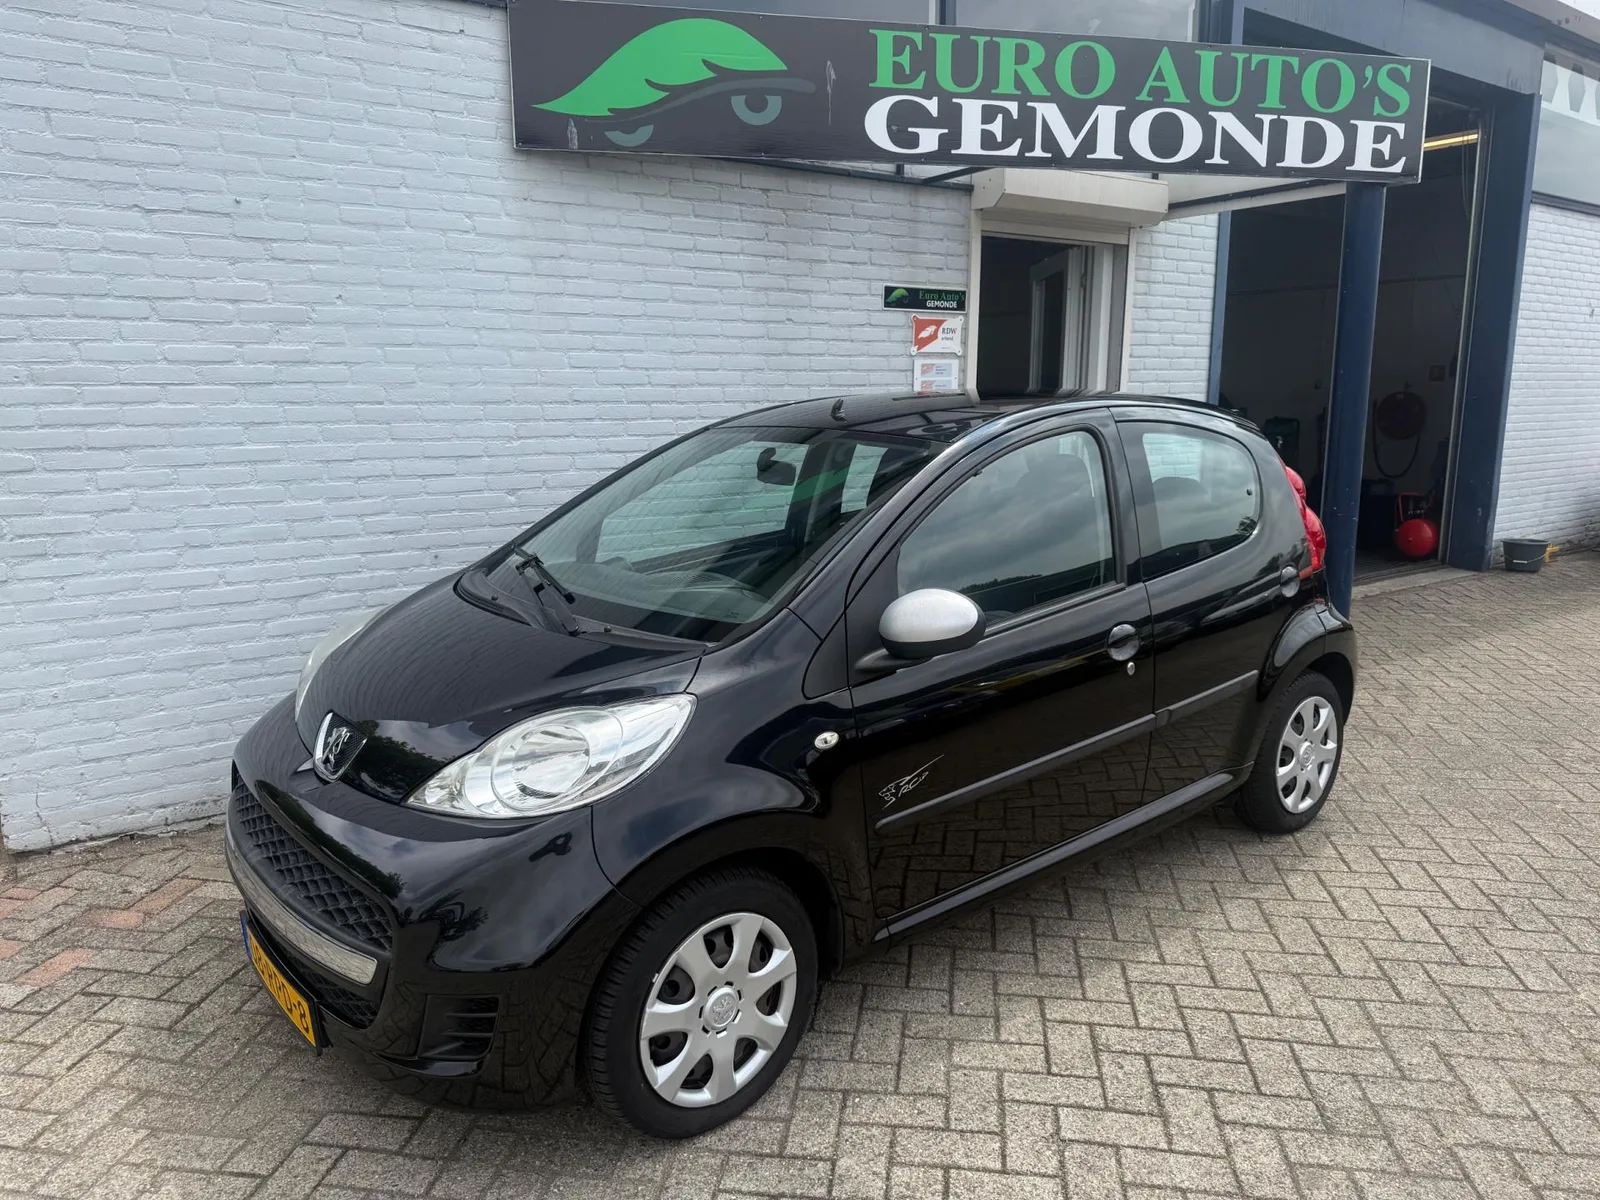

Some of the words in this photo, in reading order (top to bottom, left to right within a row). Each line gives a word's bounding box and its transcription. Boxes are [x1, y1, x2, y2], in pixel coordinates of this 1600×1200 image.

[868, 28, 1116, 99] EURO
[1135, 46, 1412, 118] AUTO'S
[864, 94, 1408, 174] GEMONDE
[919, 290, 939, 300] Euro
[940, 291, 965, 301] Auto's
[926, 300, 958, 309] GEMONDE
[941, 327, 957, 335] RDW
